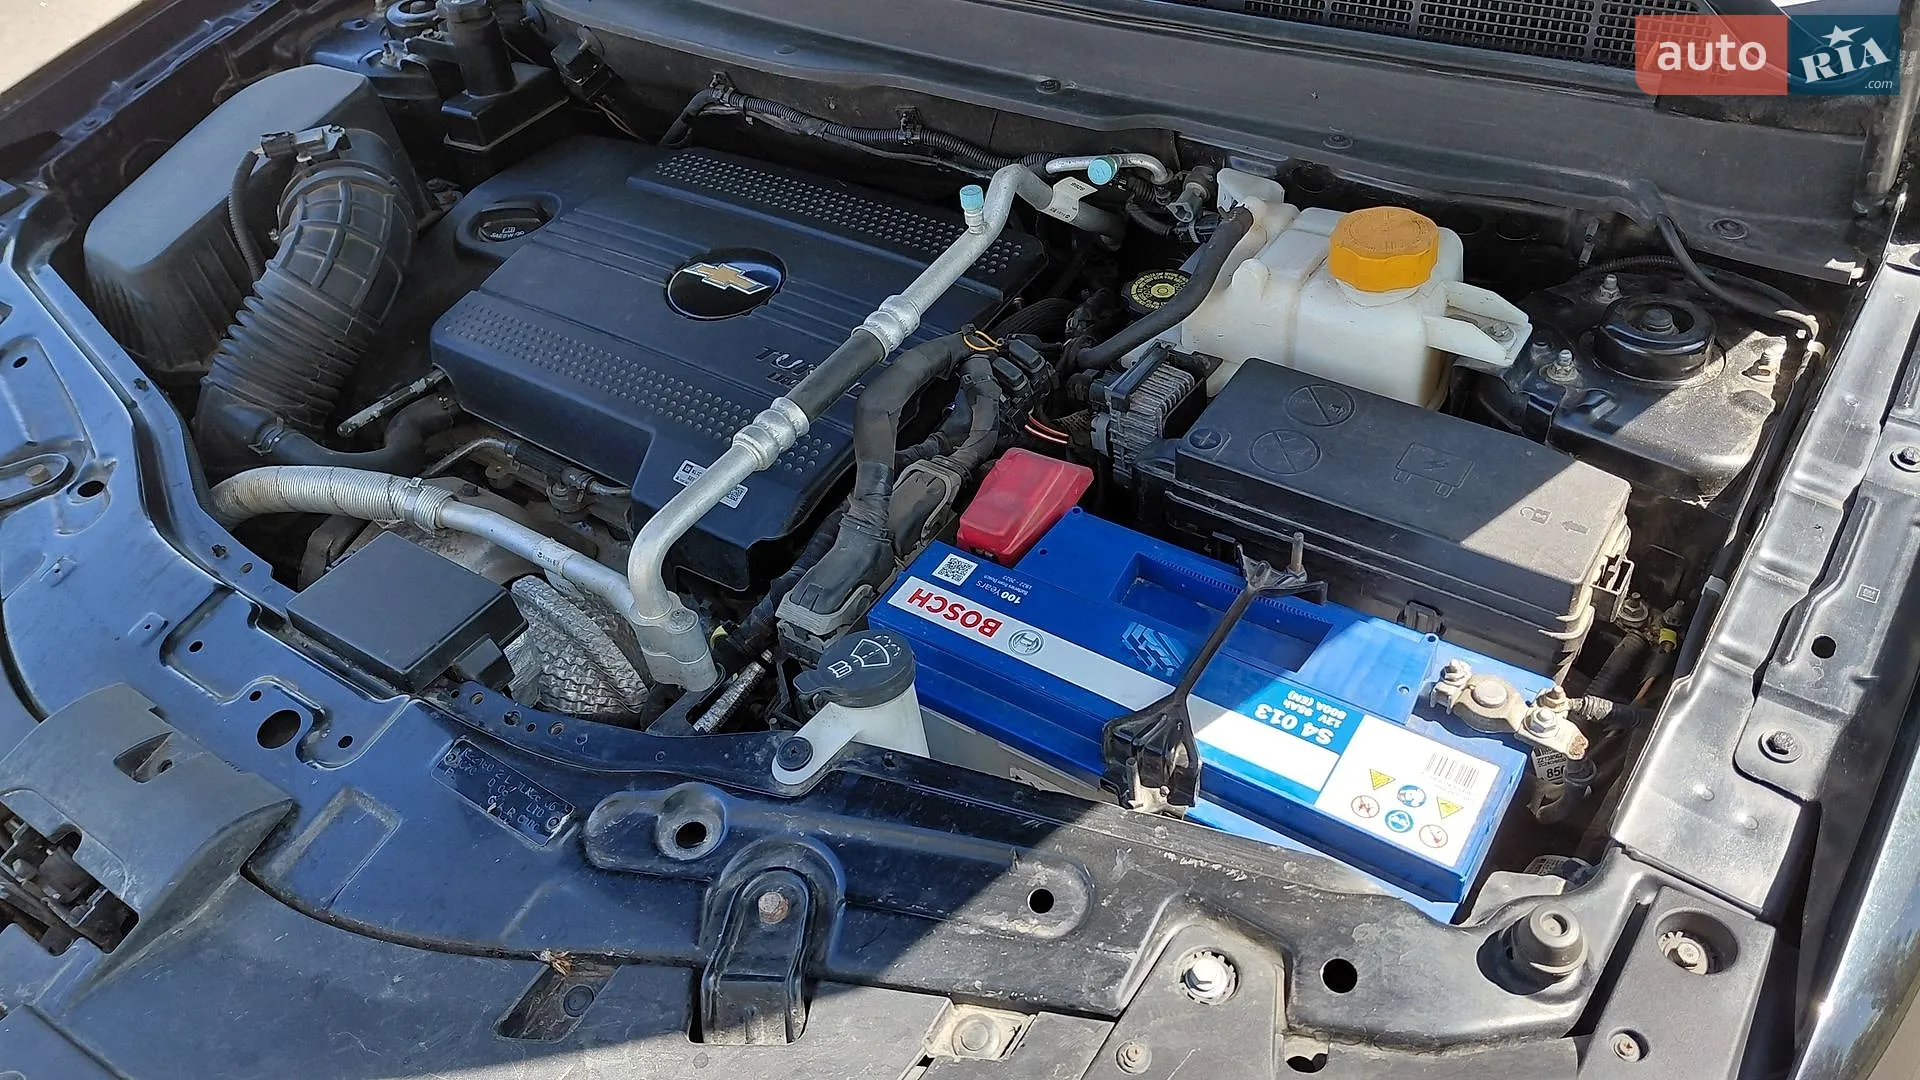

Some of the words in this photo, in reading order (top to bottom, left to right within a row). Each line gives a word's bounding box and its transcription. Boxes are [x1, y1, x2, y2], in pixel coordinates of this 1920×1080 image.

[975, 580, 1001, 597] Years
[1000, 591, 1021, 604] 100
[907, 587, 1003, 638] BOSCH
[1255, 703, 1298, 730] 013
[1316, 701, 1347, 720] 800A
[1317, 714, 1343, 728] 12V
[1301, 722, 1334, 745] S4
